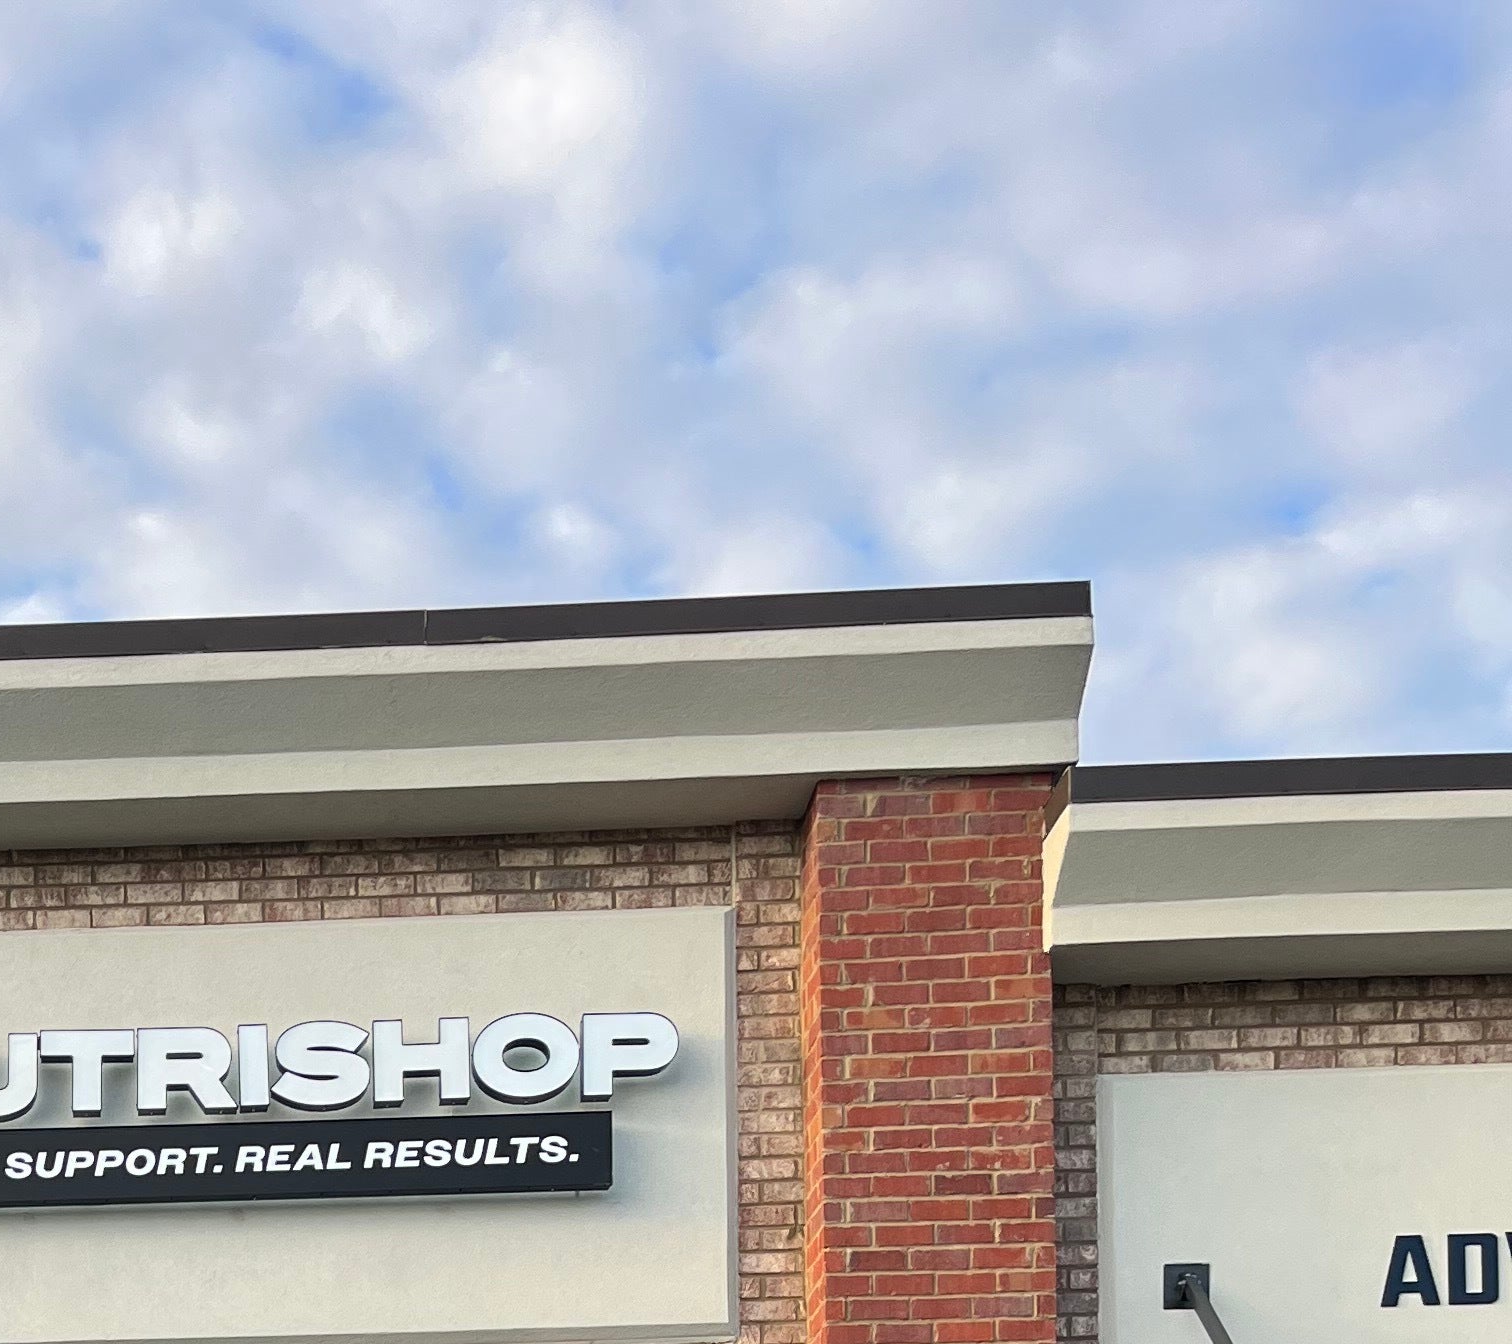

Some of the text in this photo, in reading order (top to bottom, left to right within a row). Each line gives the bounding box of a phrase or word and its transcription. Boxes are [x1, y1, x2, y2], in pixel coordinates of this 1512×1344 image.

[4, 1146, 223, 1180] SUPPORT.
[234, 1142, 352, 1174] REAL
[363, 1135, 580, 1169] RESULTS.
